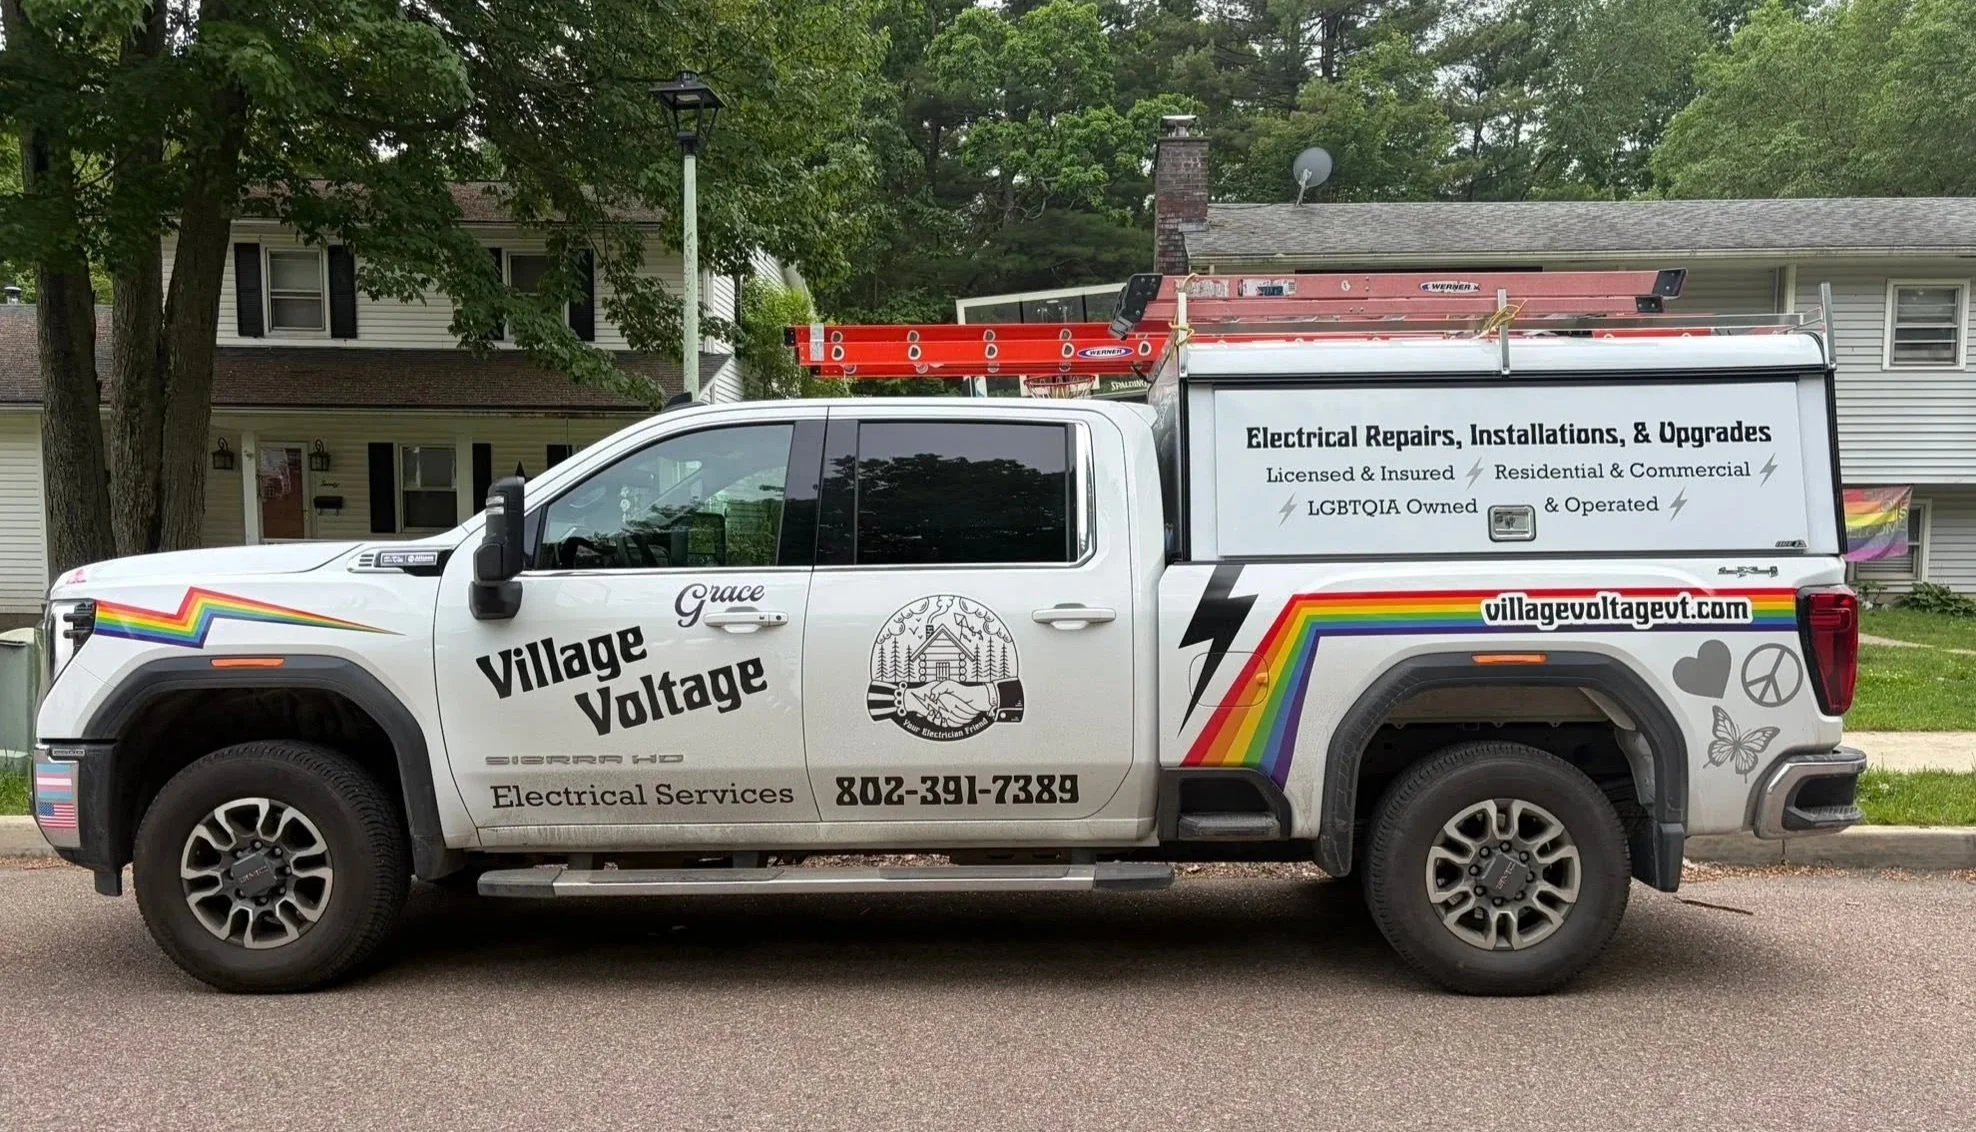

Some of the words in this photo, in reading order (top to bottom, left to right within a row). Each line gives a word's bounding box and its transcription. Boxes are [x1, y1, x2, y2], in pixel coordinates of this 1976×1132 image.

[1432, 283, 1472, 291] WERNER
[1089, 349, 1122, 357] WERNER
[1110, 379, 1148, 391] SPALDING
[1246, 425, 1358, 449] Electrical
[1365, 424, 1462, 451] Repairs,
[1470, 423, 1626, 448] Installations,
[1633, 421, 1651, 444] &
[1659, 421, 1772, 448] Upgrades
[1266, 466, 1355, 483] Licensed
[1360, 466, 1375, 482] &
[1380, 465, 1456, 481] Insured
[1494, 463, 1604, 480] Residential
[1609, 463, 1624, 479] &
[1630, 461, 1751, 479] Commercial
[1307, 499, 1401, 518] LGBTQIA
[1406, 498, 1479, 515] Owned
[1544, 497, 1559, 512] &
[1564, 496, 1660, 516] Operated
[674, 583, 765, 628] Grace
[1485, 595, 1749, 625] villagevoltagevt.com
[475, 625, 648, 699] Village
[574, 657, 768, 736] Voltage
[902, 718, 920, 733] Your
[922, 728, 964, 739] Electrician
[965, 717, 989, 734] Friend
[485, 755, 623, 766] SIERRA
[632, 754, 684, 764] HD
[490, 784, 648, 809] Electrical
[655, 783, 795, 806] Services
[835, 774, 1080, 806] 802-391-7389
